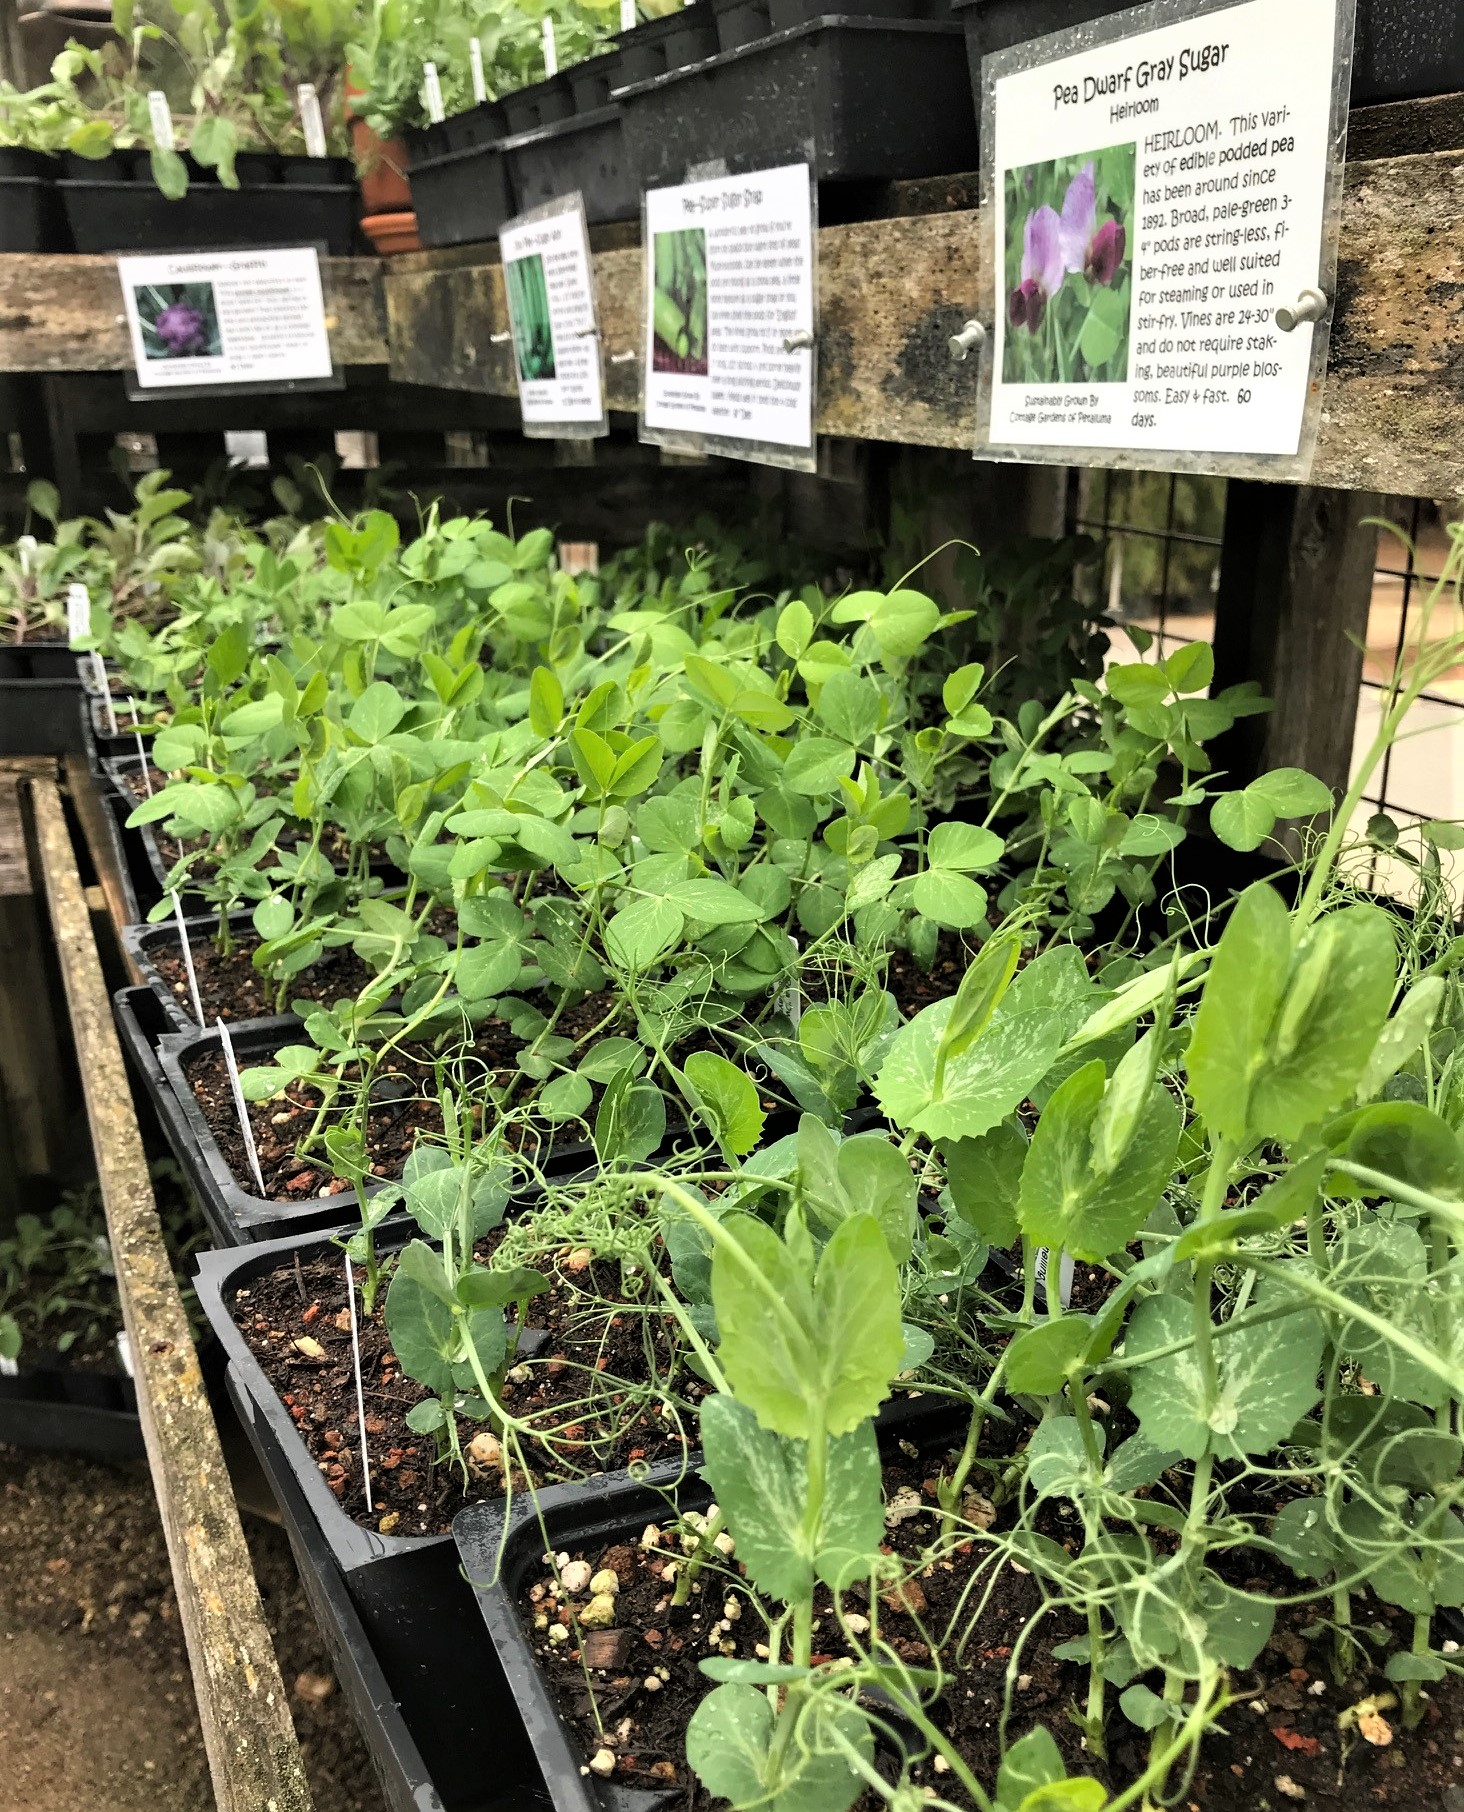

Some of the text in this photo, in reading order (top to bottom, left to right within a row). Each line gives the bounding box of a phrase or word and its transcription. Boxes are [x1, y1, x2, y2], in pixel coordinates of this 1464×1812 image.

[1053, 43, 1229, 111] Pea Dwarf Gray Sugar
[1110, 97, 1159, 124] Heirloom
[1144, 119, 1222, 154] HEIRLOOM.
[1229, 112, 1258, 136] This
[1143, 136, 1295, 178] ety of edible podded pea
[1143, 168, 1276, 205] has been around since
[1142, 194, 1293, 230] 1892. Broad, pale-green 3-
[1153, 235, 1180, 256] pods
[1183, 235, 1202, 251] are
[1205, 224, 1270, 248] string-less,
[1274, 220, 1290, 241] fi-
[1140, 249, 1281, 281] ber-free and well suited
[1139, 278, 1274, 307] for steaming or used in
[1137, 314, 1177, 331] stir-fry.
[1181, 310, 1212, 330] Vines
[1215, 311, 1235, 326] are
[1136, 334, 1277, 355] and do not require stak-
[1135, 360, 1283, 381] ing, beautiful purple blos-
[1133, 389, 1161, 403] soms.
[1165, 387, 1190, 405] Easy
[1202, 387, 1230, 404] fast.
[1237, 387, 1252, 404] 60
[1131, 411, 1157, 428] days.
